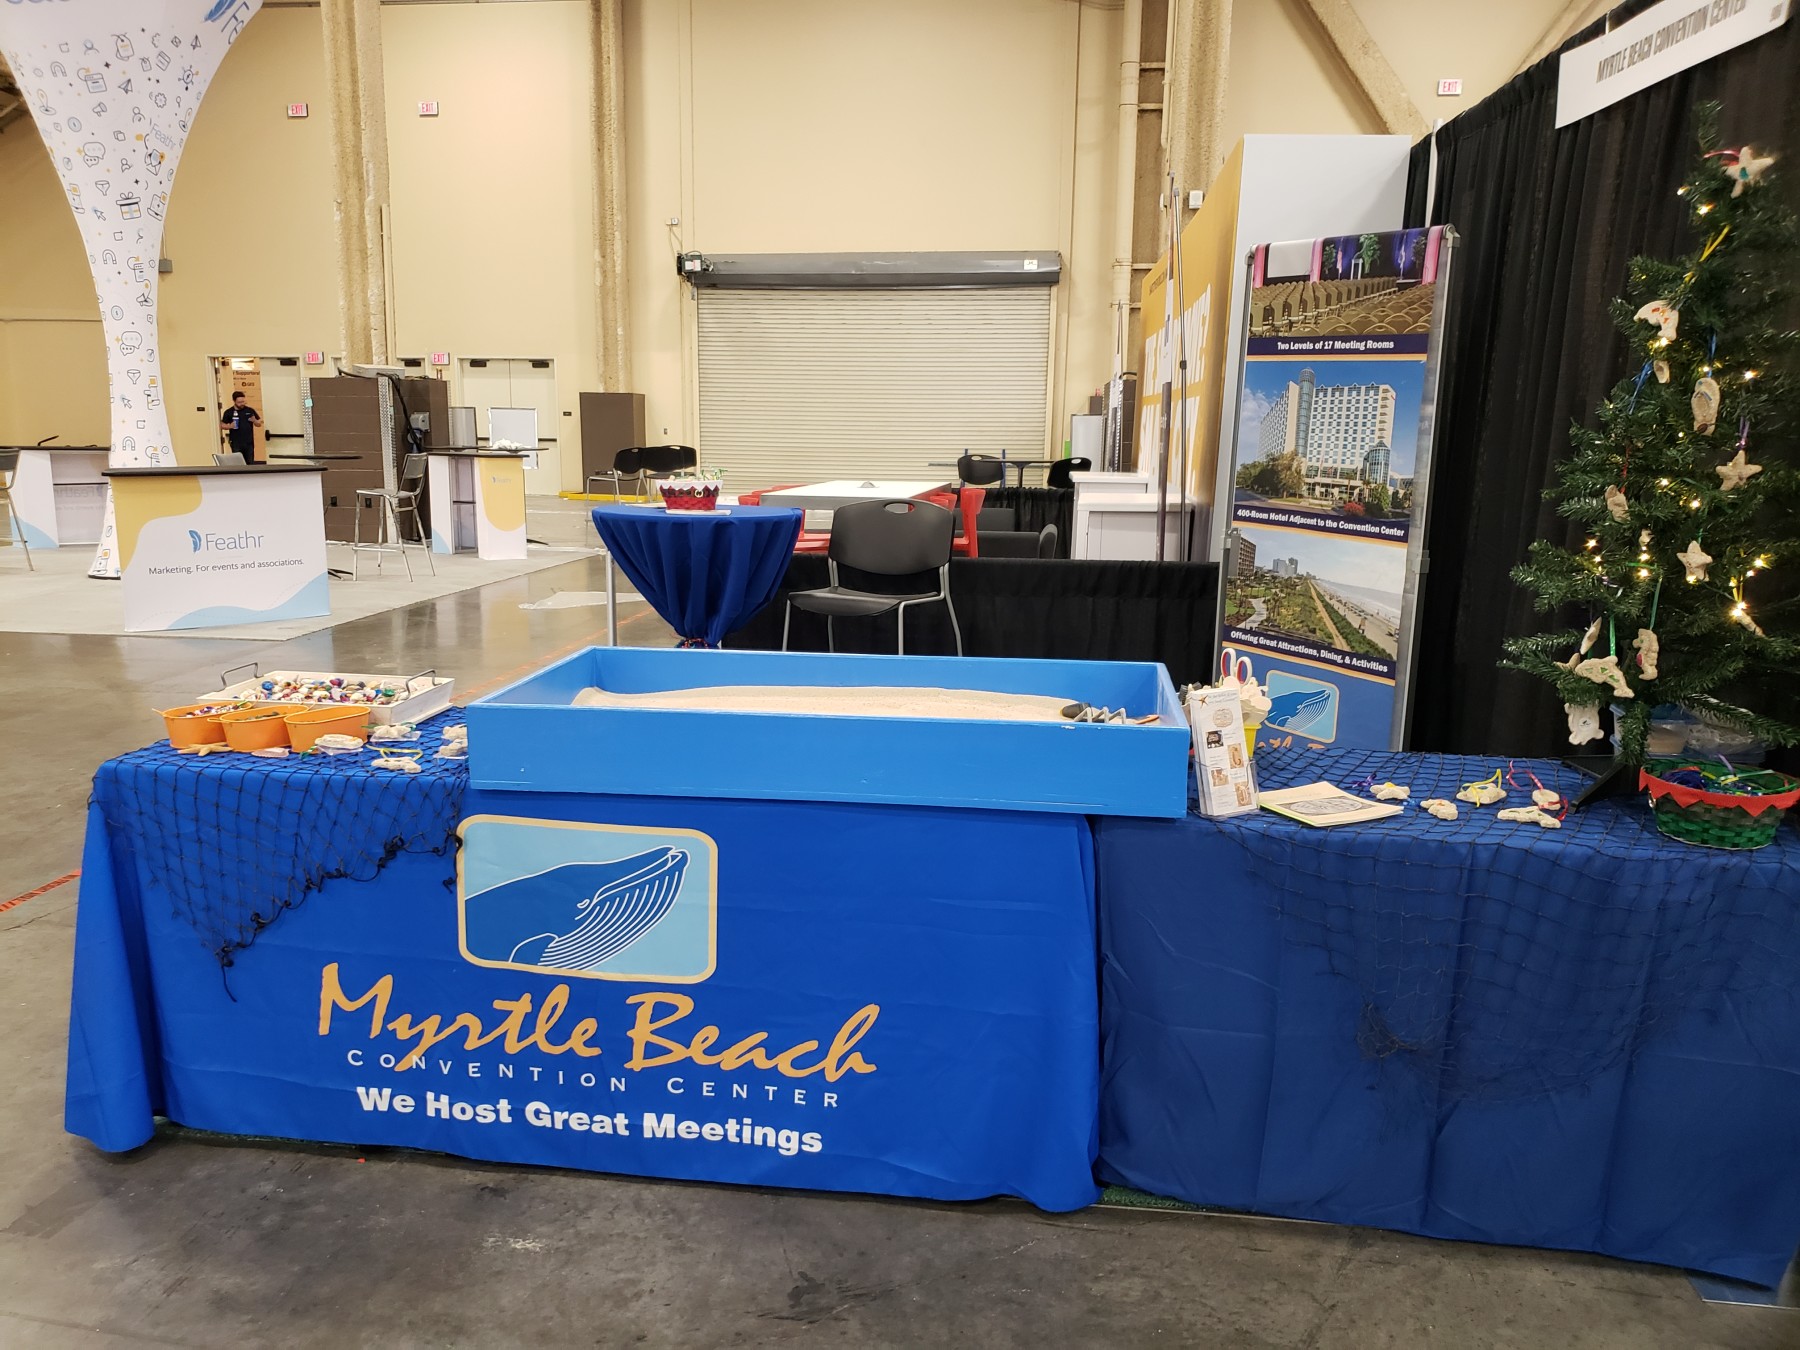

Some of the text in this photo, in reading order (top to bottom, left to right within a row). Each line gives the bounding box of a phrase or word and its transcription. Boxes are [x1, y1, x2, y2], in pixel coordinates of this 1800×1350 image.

[1596, 48, 1628, 83] MYRTLE
[1627, 34, 1653, 68] BEACH
[1653, 5, 1709, 55] CONVENTION
[1443, 81, 1457, 92] EXIT
[291, 104, 303, 115] EXIT
[421, 103, 434, 113] EXIT
[1278, 340, 1394, 350] Two Levels of 17 Meeting Rooms
[307, 352, 319, 362] EXIT
[434, 354, 445, 363] EXIT
[1237, 508, 1268, 520] 400-Room
[1270, 512, 1288, 522] Hotel
[1290, 515, 1316, 526] Adjacent
[1326, 520, 1338, 528] the
[1339, 520, 1380, 534] Convention
[1380, 526, 1404, 536] Center
[205, 531, 264, 551] Feathr
[148, 558, 304, 575] Marketing. For events and associations.
[1230, 630, 1388, 672] Offering Great Attractions, Dining, & Activities
[318, 962, 880, 1082] Myrtle Beach
[347, 1050, 838, 1108] CONVENTION CENTER
[356, 1086, 822, 1156] We Host Great Meetings
